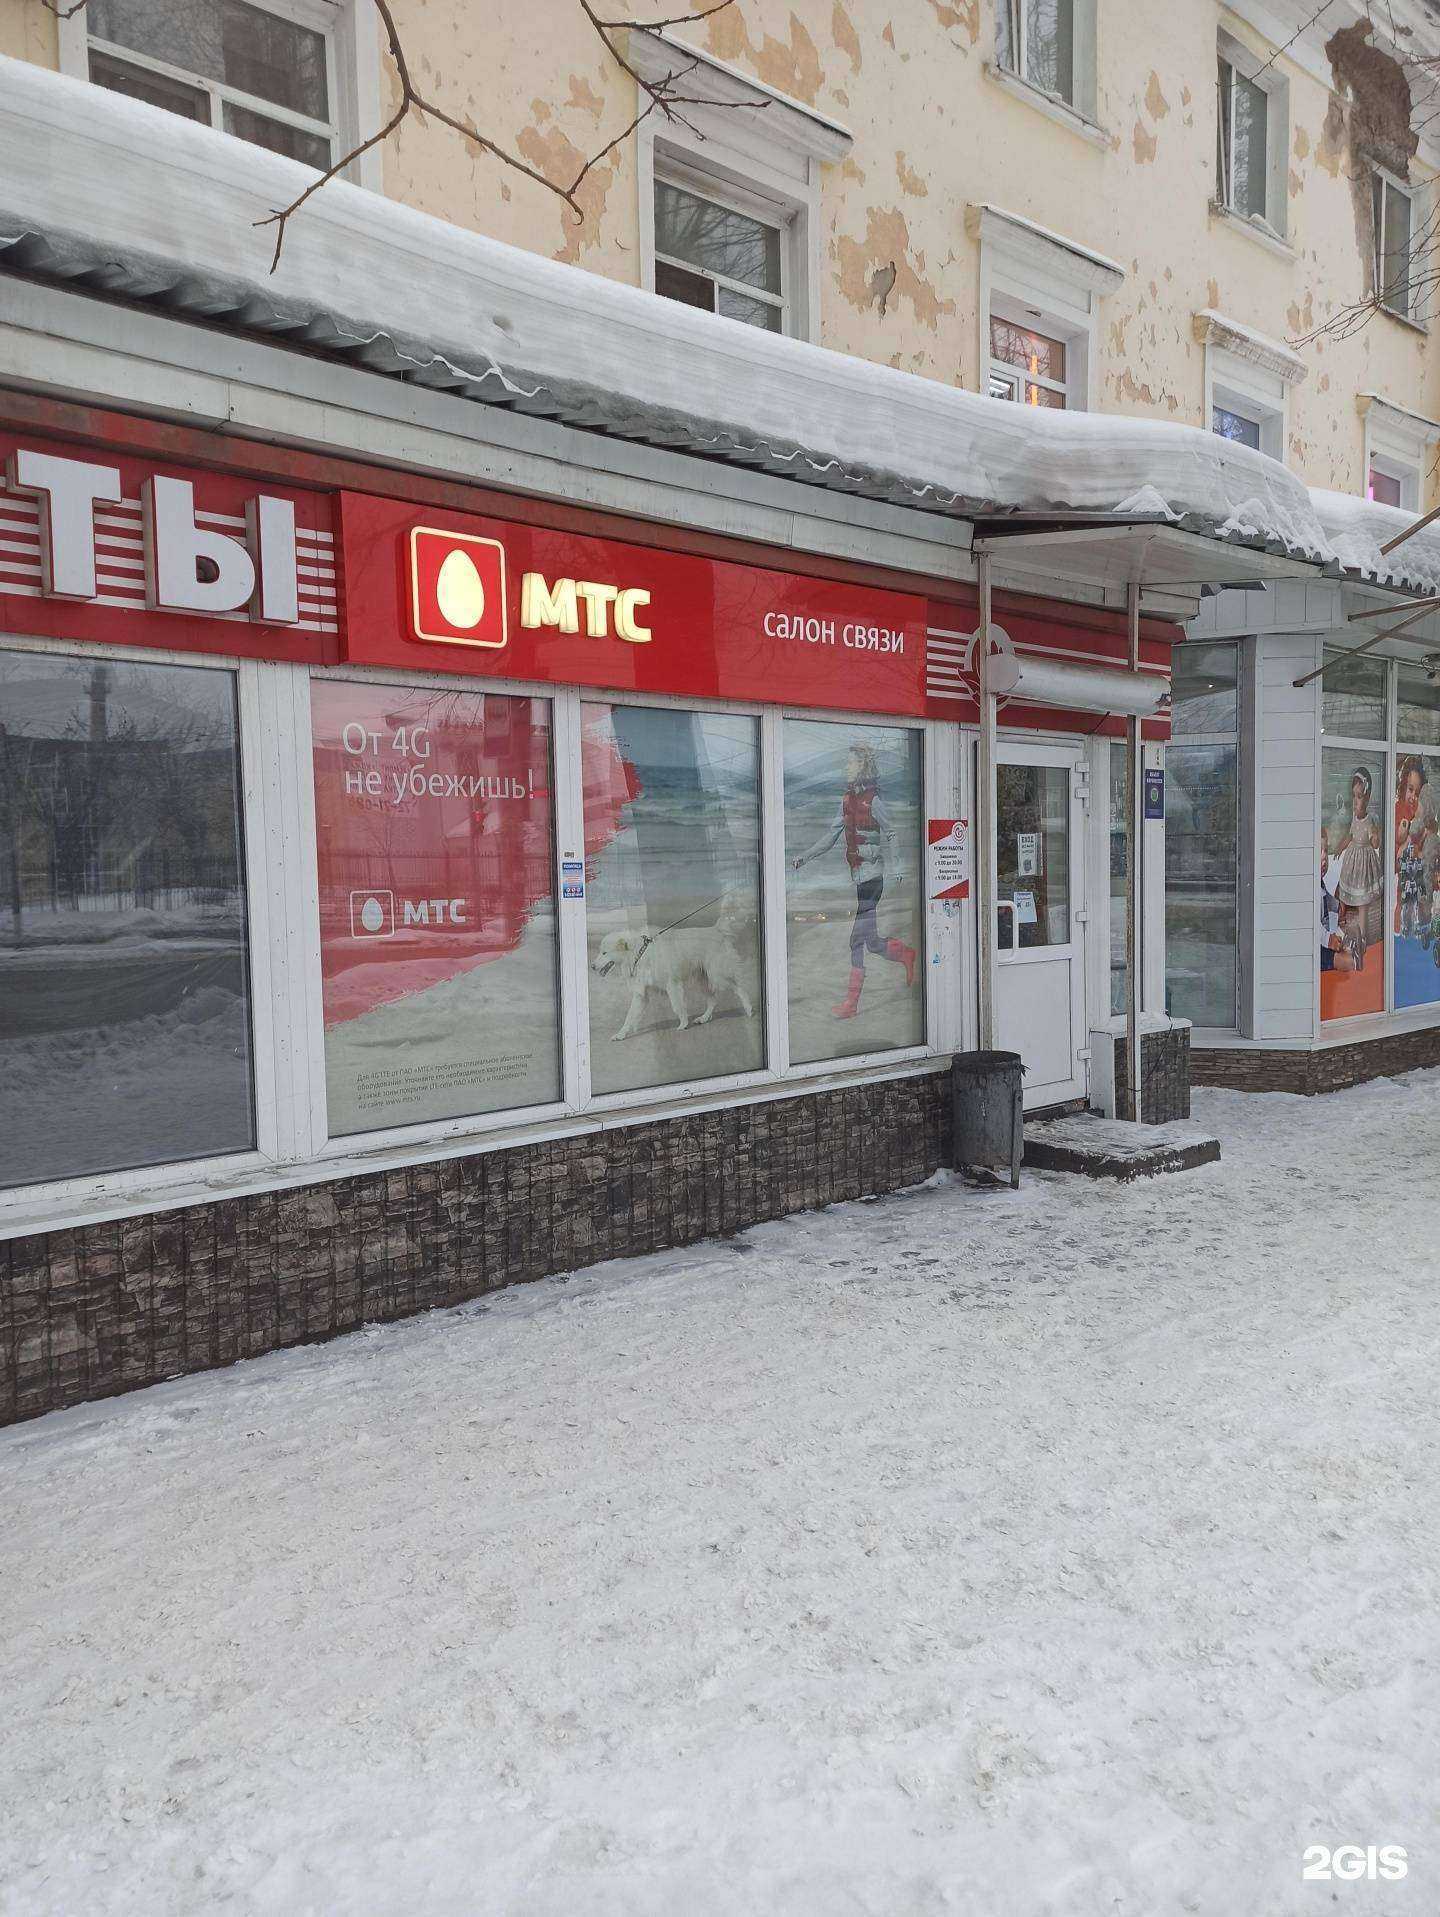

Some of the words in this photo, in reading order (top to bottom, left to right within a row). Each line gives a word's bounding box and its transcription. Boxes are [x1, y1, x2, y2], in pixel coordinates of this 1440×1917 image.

[521, 572, 652, 643] МТС
[763, 612, 835, 645] салон
[842, 624, 905, 654] связи
[342, 722, 383, 756] От
[392, 727, 430, 758] 4G
[345, 770, 382, 795] не
[393, 764, 535, 804] убежишь!
[403, 899, 466, 925] МТС
